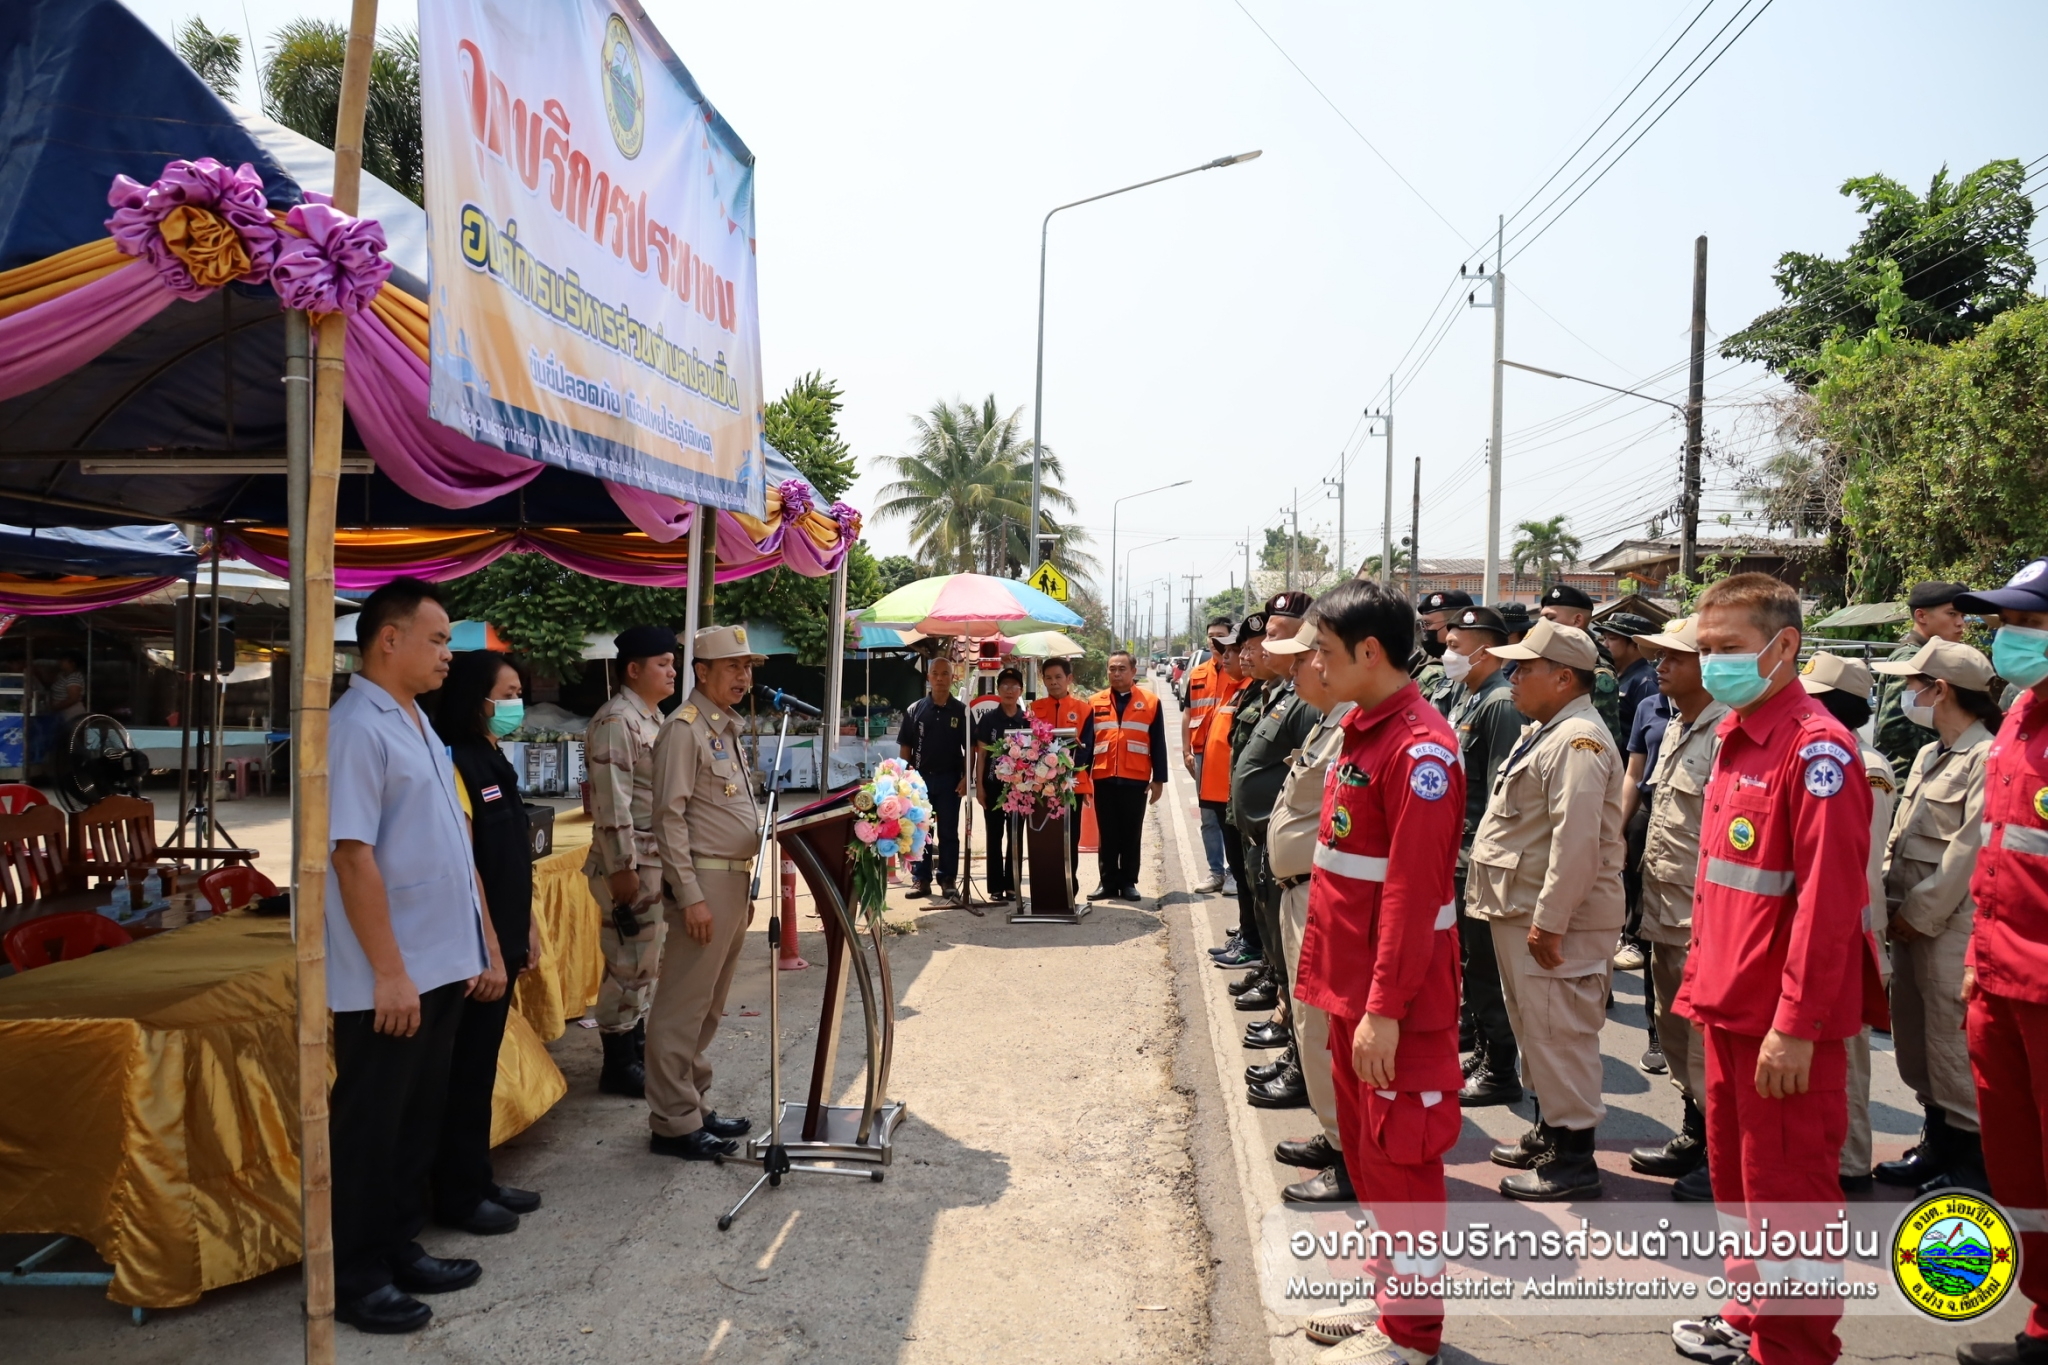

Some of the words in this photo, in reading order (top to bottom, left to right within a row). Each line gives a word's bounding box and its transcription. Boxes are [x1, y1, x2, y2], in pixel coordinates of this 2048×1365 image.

[457, 38, 738, 335] จุดบริการประชาชน
[461, 204, 740, 412] องค์การบริหารส่วนตำบลม่อนปิ่น
[529, 348, 621, 414] ขับขี่ปลอดภัย
[1415, 745, 1451, 761] RESCUE
[1806, 744, 1846, 760] RESCUE
